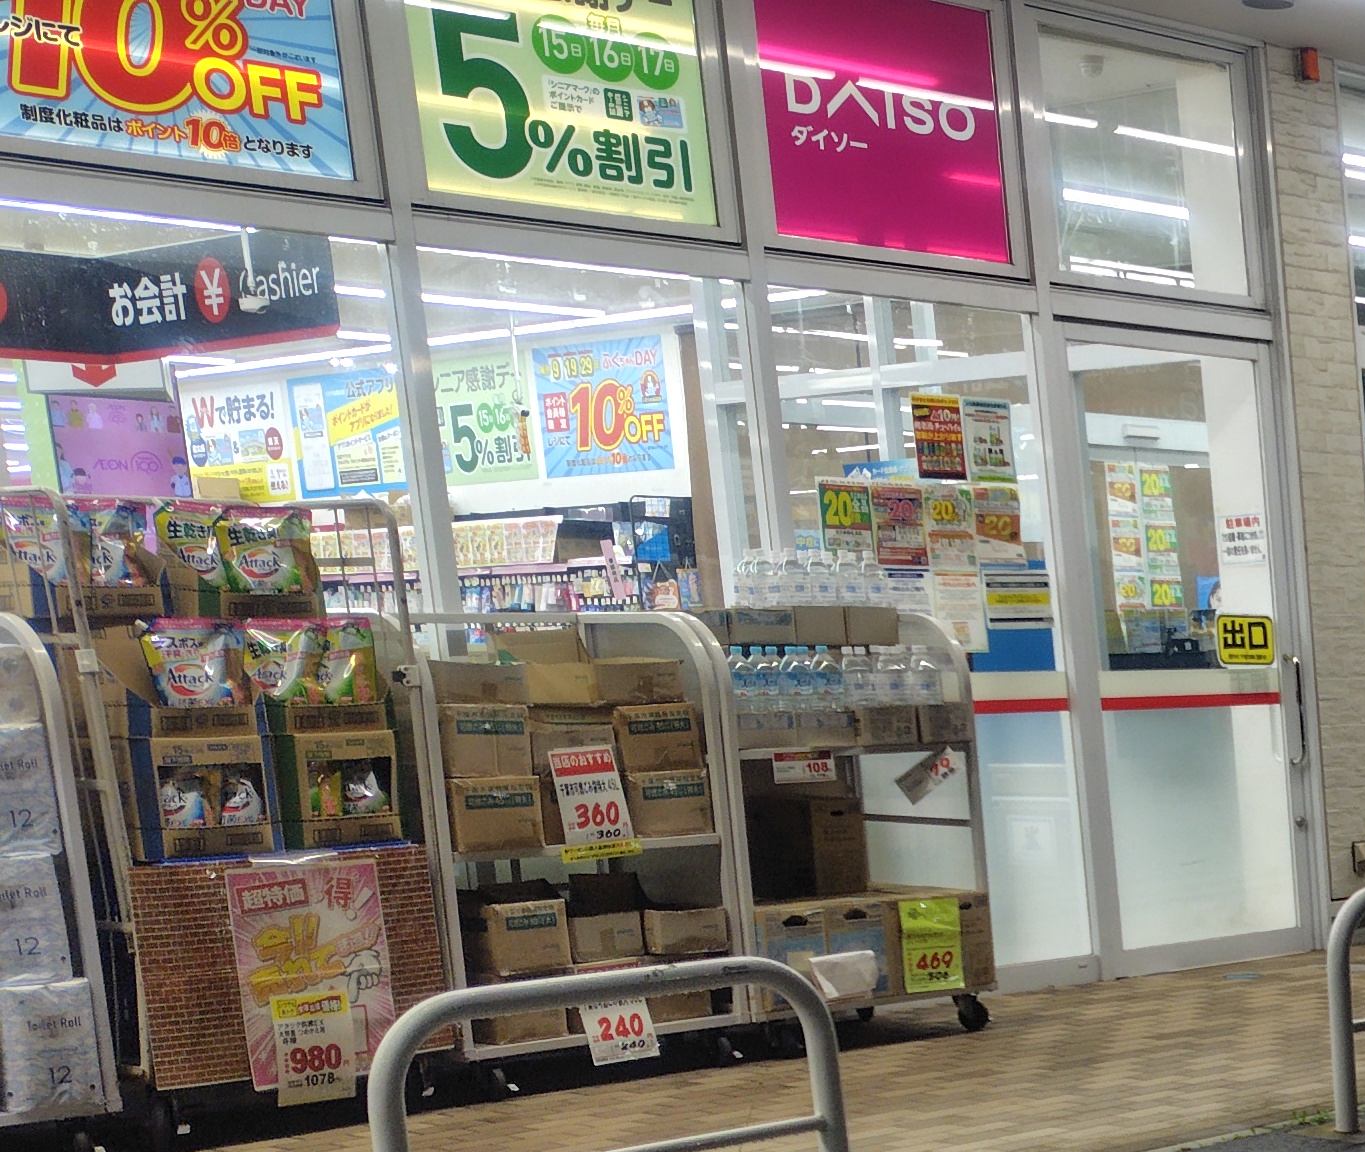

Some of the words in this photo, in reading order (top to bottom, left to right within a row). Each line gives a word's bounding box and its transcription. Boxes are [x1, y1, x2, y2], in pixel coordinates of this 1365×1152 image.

[194, 55, 322, 124] OFF
[785, 72, 975, 141] DAISO
[791, 125, 867, 153] ダイソー
[108, 271, 187, 327] お会計
[192, 391, 275, 429] Wで貯まる!
[624, 412, 665, 444] OFF
[823, 489, 852, 526] 20
[889, 500, 914, 520] 20
[932, 501, 954, 521] 20
[985, 515, 1012, 536] 20
[238, 550, 282, 568] Attack
[1223, 620, 1269, 650] 出口
[167, 668, 214, 686] Attack
[806, 762, 830, 774] 108
[10, 809, 34, 828] 12
[575, 801, 620, 829] 360
[597, 829, 621, 839] 360
[241, 883, 307, 912] 超特価
[16, 937, 42, 956] 12
[27, 1020, 58, 1032] Toilet
[61, 1016, 82, 1029] Roll
[598, 1013, 644, 1042] 240
[290, 1043, 342, 1074] 980
[49, 1066, 73, 1086] 12
[305, 1072, 335, 1086] 1078
